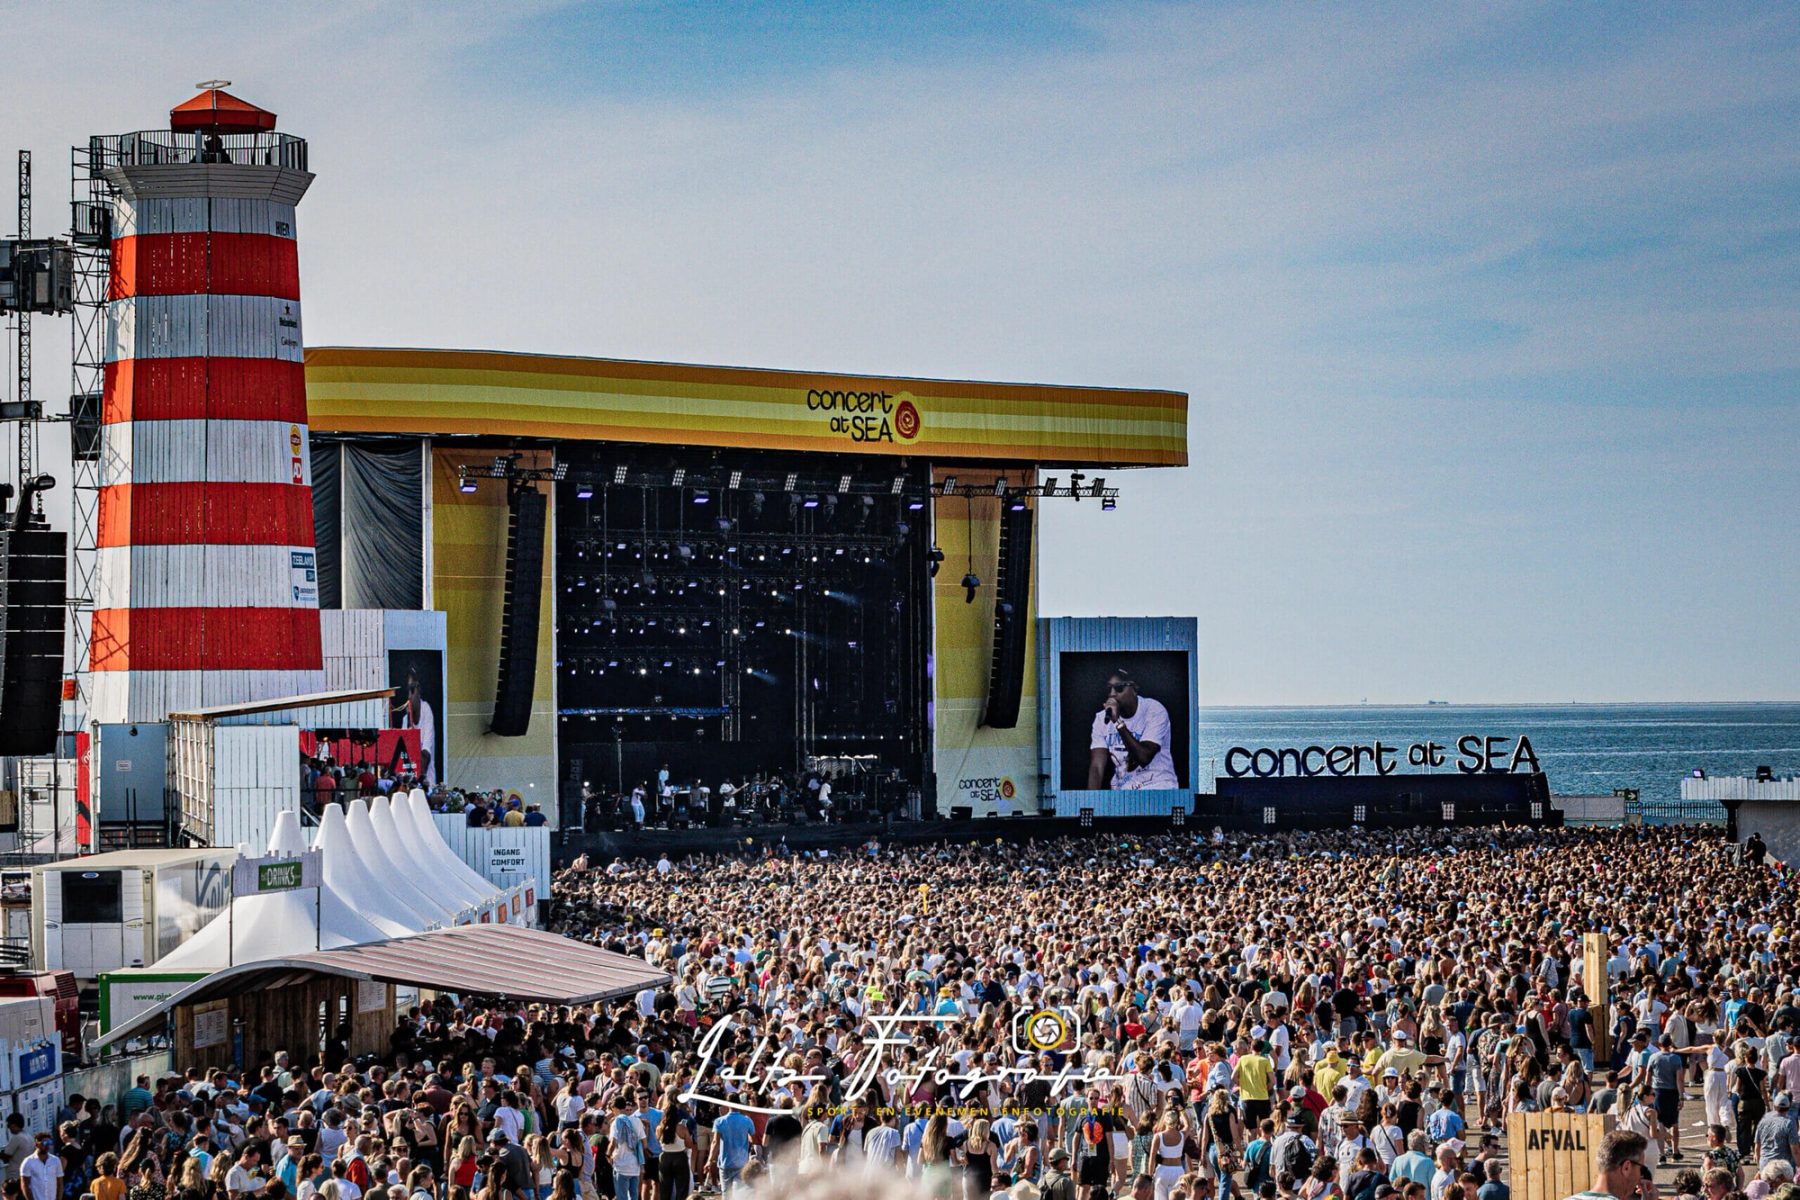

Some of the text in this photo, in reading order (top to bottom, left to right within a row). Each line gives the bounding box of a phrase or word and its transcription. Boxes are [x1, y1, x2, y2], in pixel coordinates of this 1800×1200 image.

[807, 389, 894, 414] concert
[830, 415, 893, 443] at SEA
[1225, 735, 1541, 777] concert at SEA
[959, 777, 1001, 789] concert
[970, 789, 1002, 801] at SEA
[491, 858, 526, 866] COMFORT
[493, 848, 521, 856] INGANG
[267, 865, 295, 886] DRINKS
[1528, 1128, 1586, 1151] AFVAL
